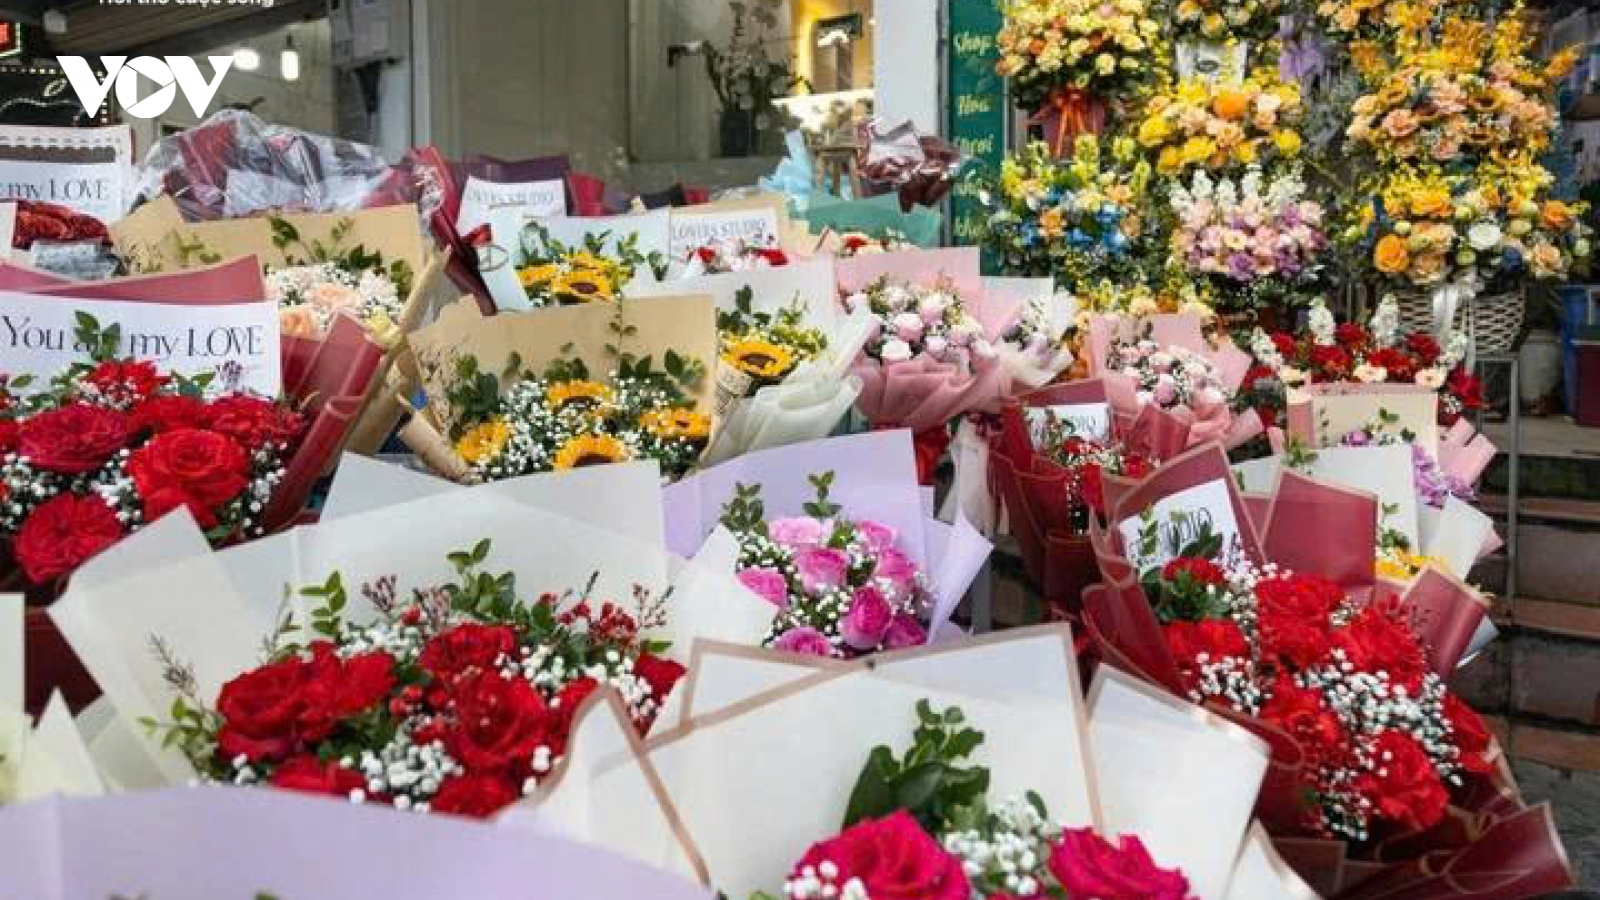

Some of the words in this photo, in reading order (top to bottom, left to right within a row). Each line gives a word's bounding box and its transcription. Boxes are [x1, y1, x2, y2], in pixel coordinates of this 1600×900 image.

[49, 178, 109, 201] LOVE
[2, 315, 64, 350] You
[130, 333, 178, 360] my
[188, 325, 263, 357] LOVE
